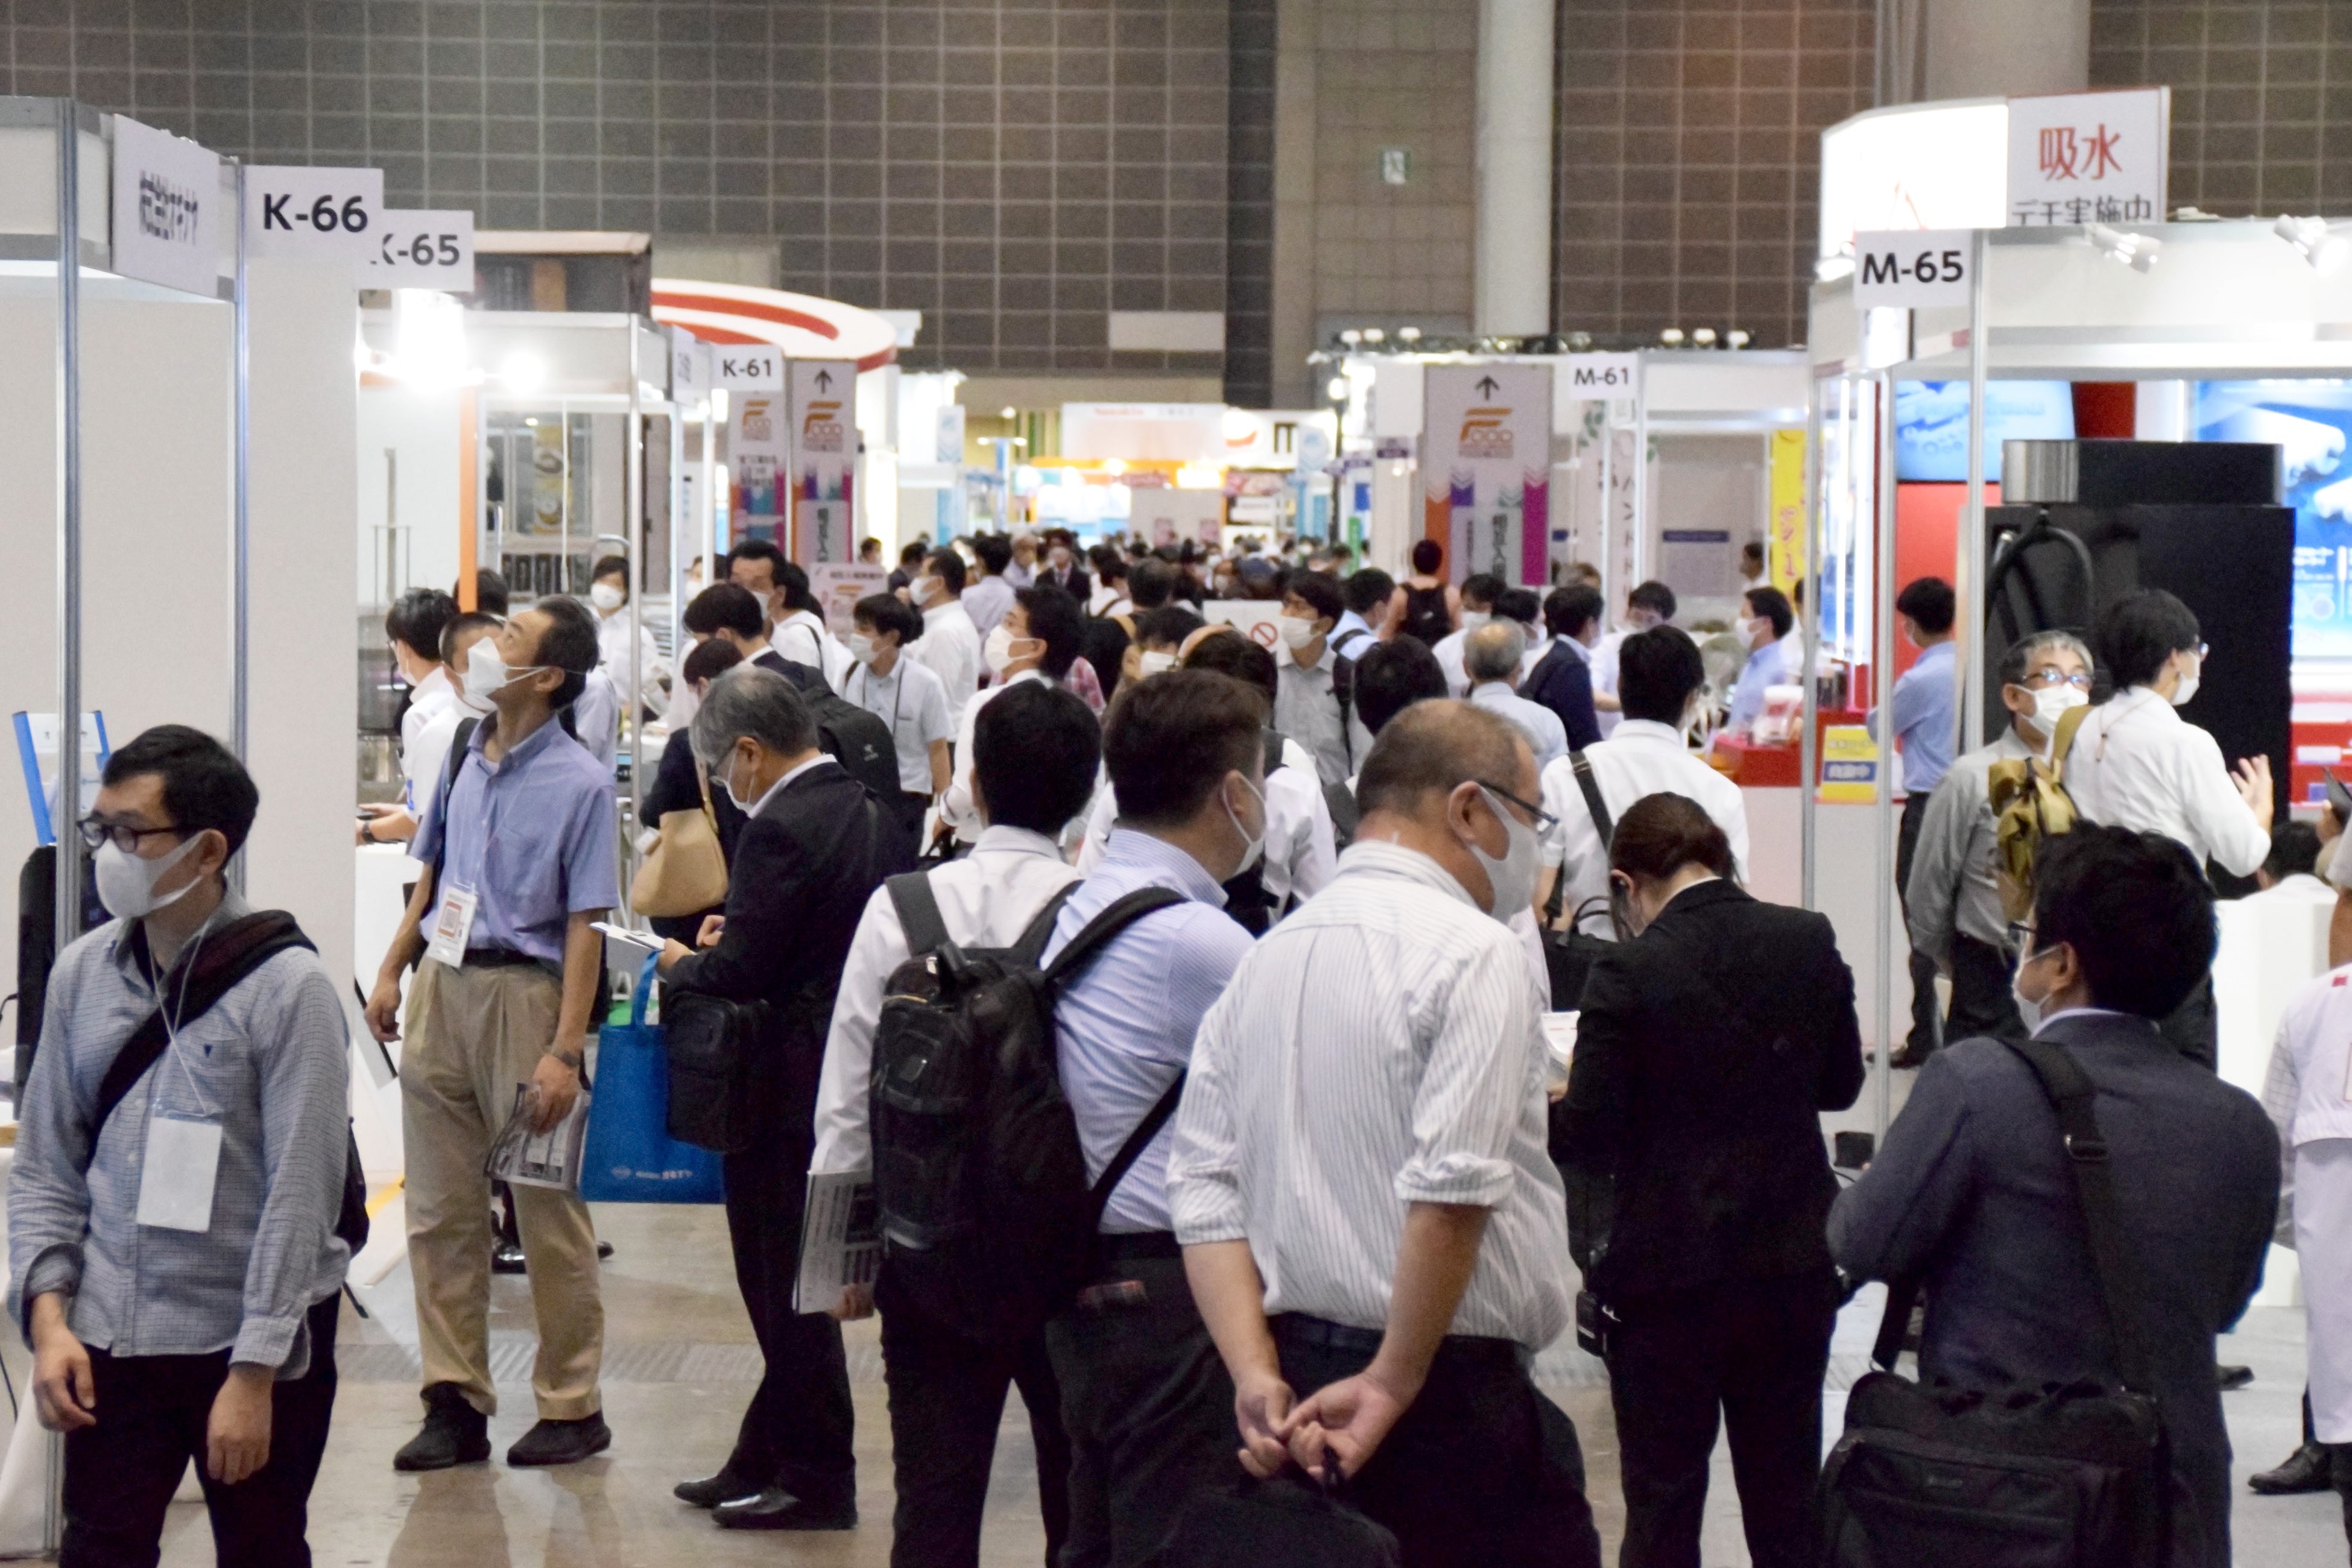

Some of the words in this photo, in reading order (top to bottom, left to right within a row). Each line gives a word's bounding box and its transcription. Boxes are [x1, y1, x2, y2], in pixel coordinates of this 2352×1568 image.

[2039, 123, 2123, 180] 吸水
[263, 193, 368, 233] K-66
[1861, 250, 1964, 285] M-65
[722, 358, 772, 378] K-61
[1574, 366, 1629, 386] M-61
